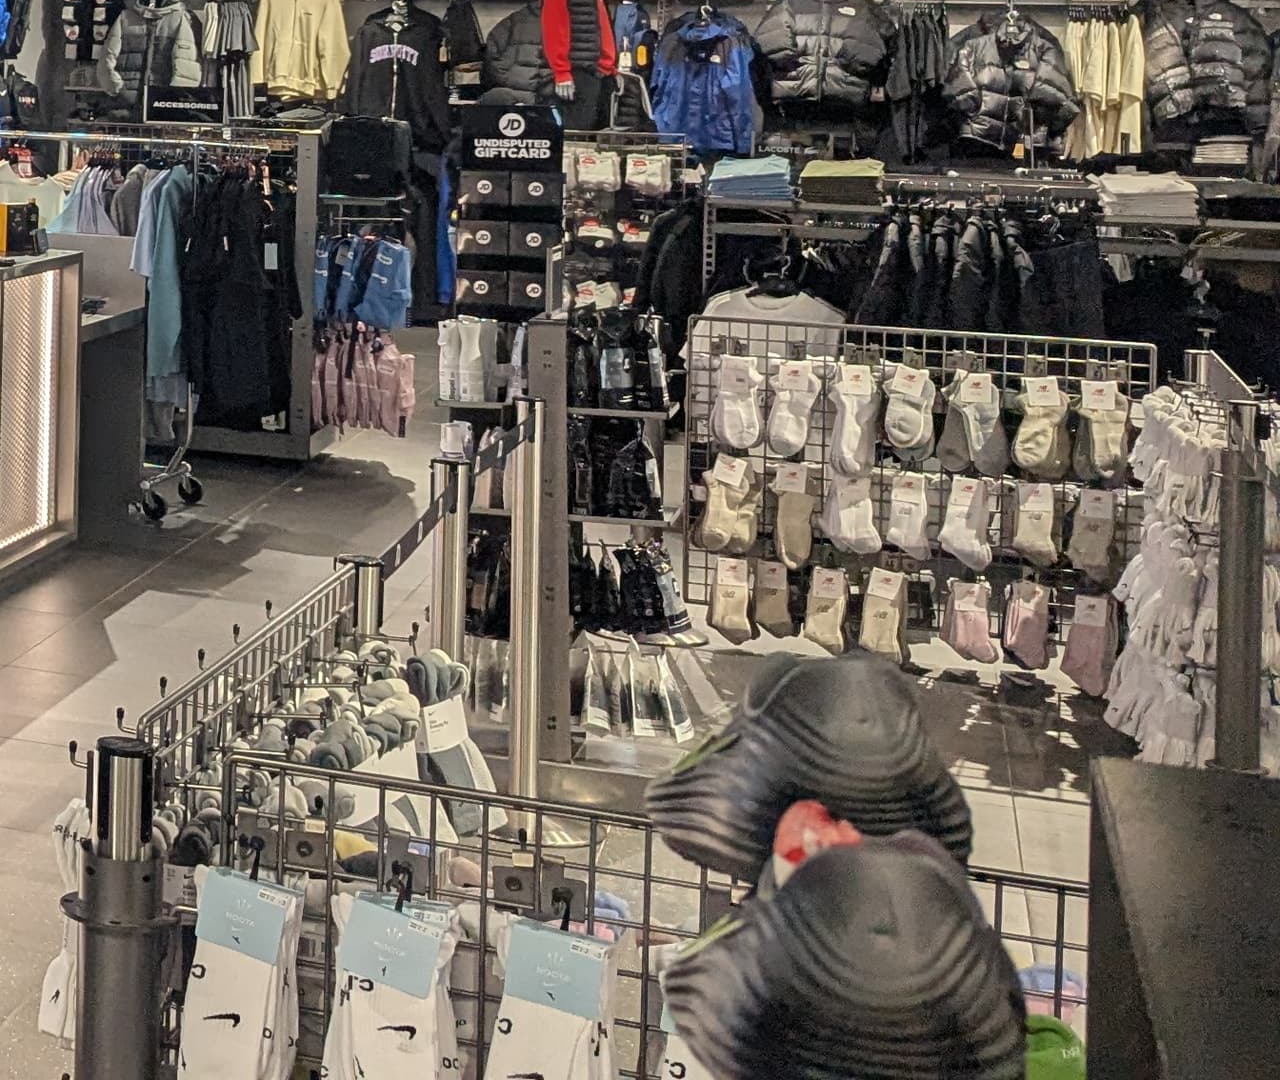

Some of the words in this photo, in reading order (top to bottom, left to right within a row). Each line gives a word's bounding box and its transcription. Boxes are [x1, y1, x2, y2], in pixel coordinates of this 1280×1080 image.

[153, 101, 219, 110] ACCESSORIES
[474, 139, 551, 148] UNDISPUTED
[475, 148, 551, 159] GIFTCARD
[758, 145, 801, 154] LACOSTE
